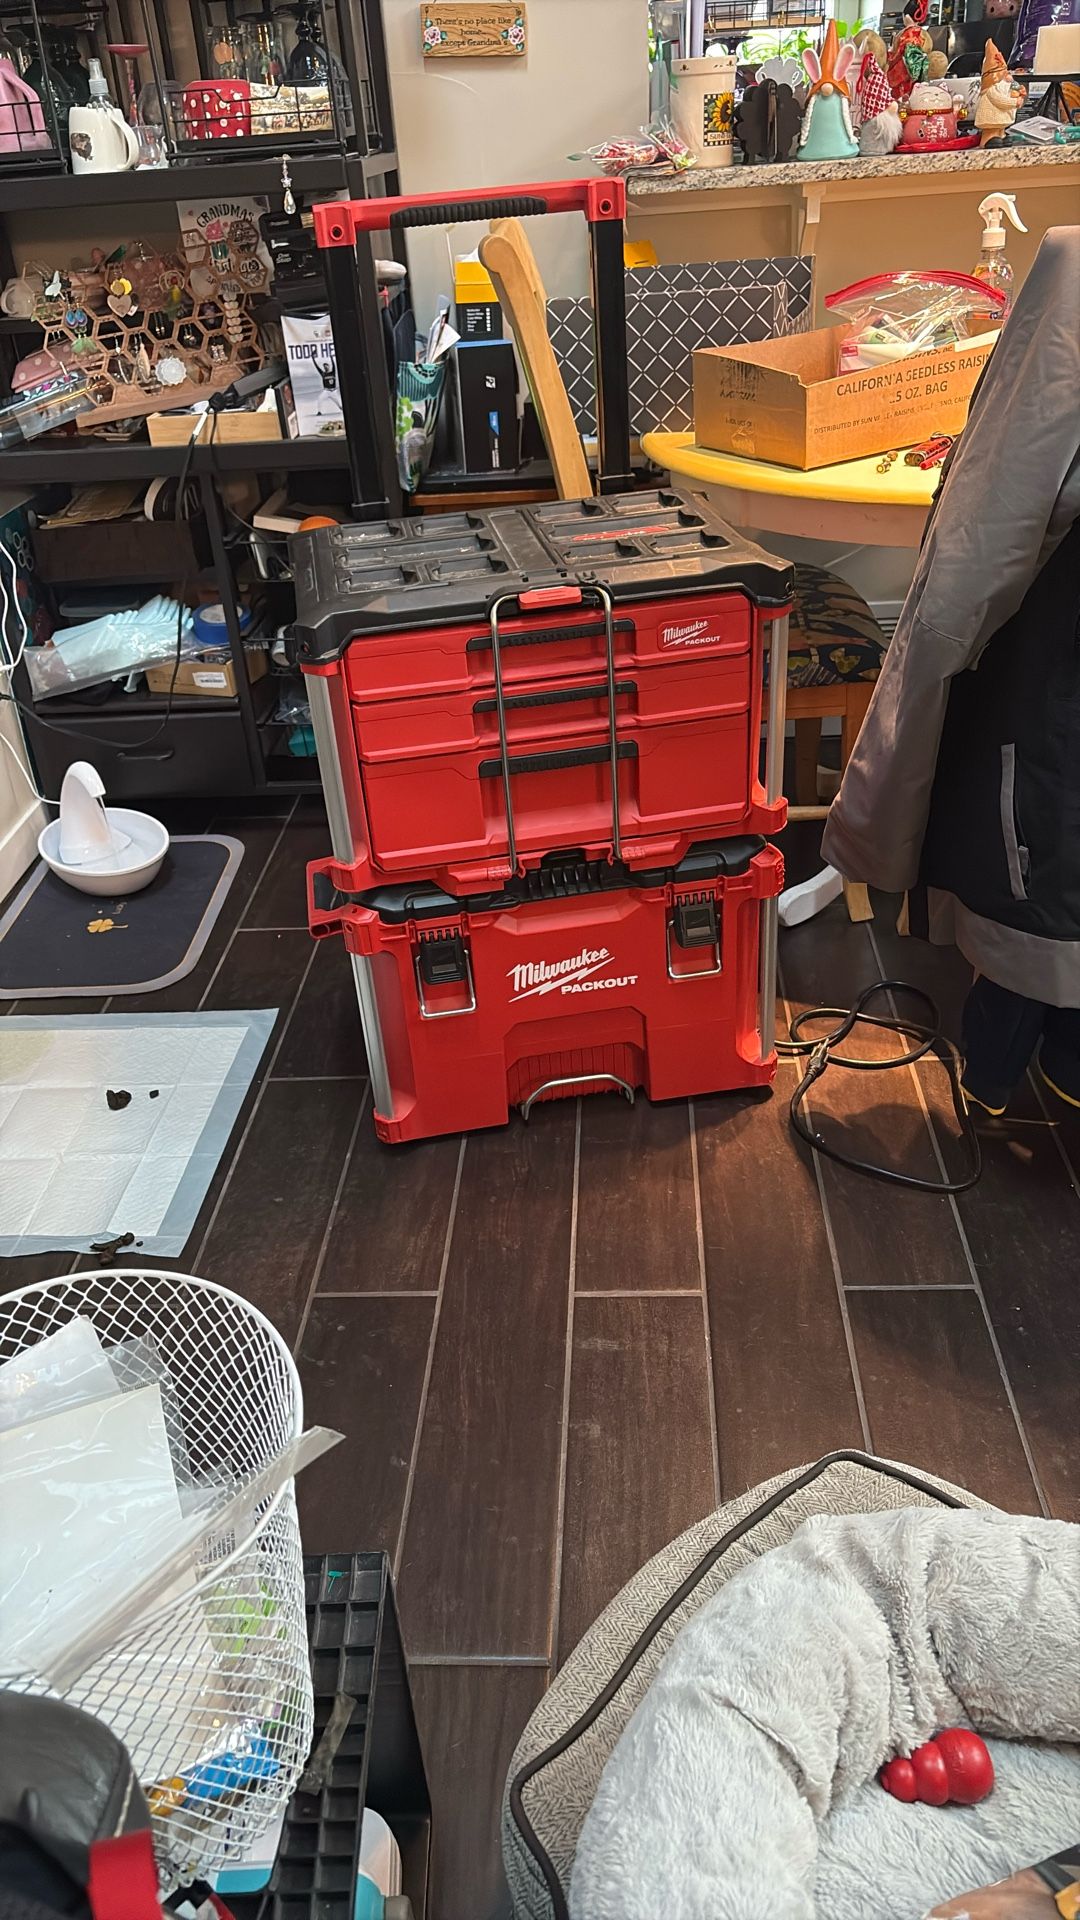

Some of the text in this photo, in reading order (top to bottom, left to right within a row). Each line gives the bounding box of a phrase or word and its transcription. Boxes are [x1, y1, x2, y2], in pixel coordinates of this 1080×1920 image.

[434, 17, 463, 25] There's
[475, 17, 496, 26] place
[440, 38, 508, 48] except Grandma's
[197, 203, 255, 228] GRANDMAS
[288, 343, 318, 360] TODD
[905, 360, 956, 382] SEEDLESS
[905, 386, 922, 400] OZ.
[925, 380, 948, 396] BAG
[814, 420, 852, 435] DISTRIBUTED
[852, 418, 861, 428] BY
[861, 416, 873, 425] SUN
[661, 620, 709, 643] Milwaukee
[685, 635, 721, 645] PACKOUT
[506, 947, 610, 992] Milwaukee
[561, 975, 638, 995] PACKOUT
